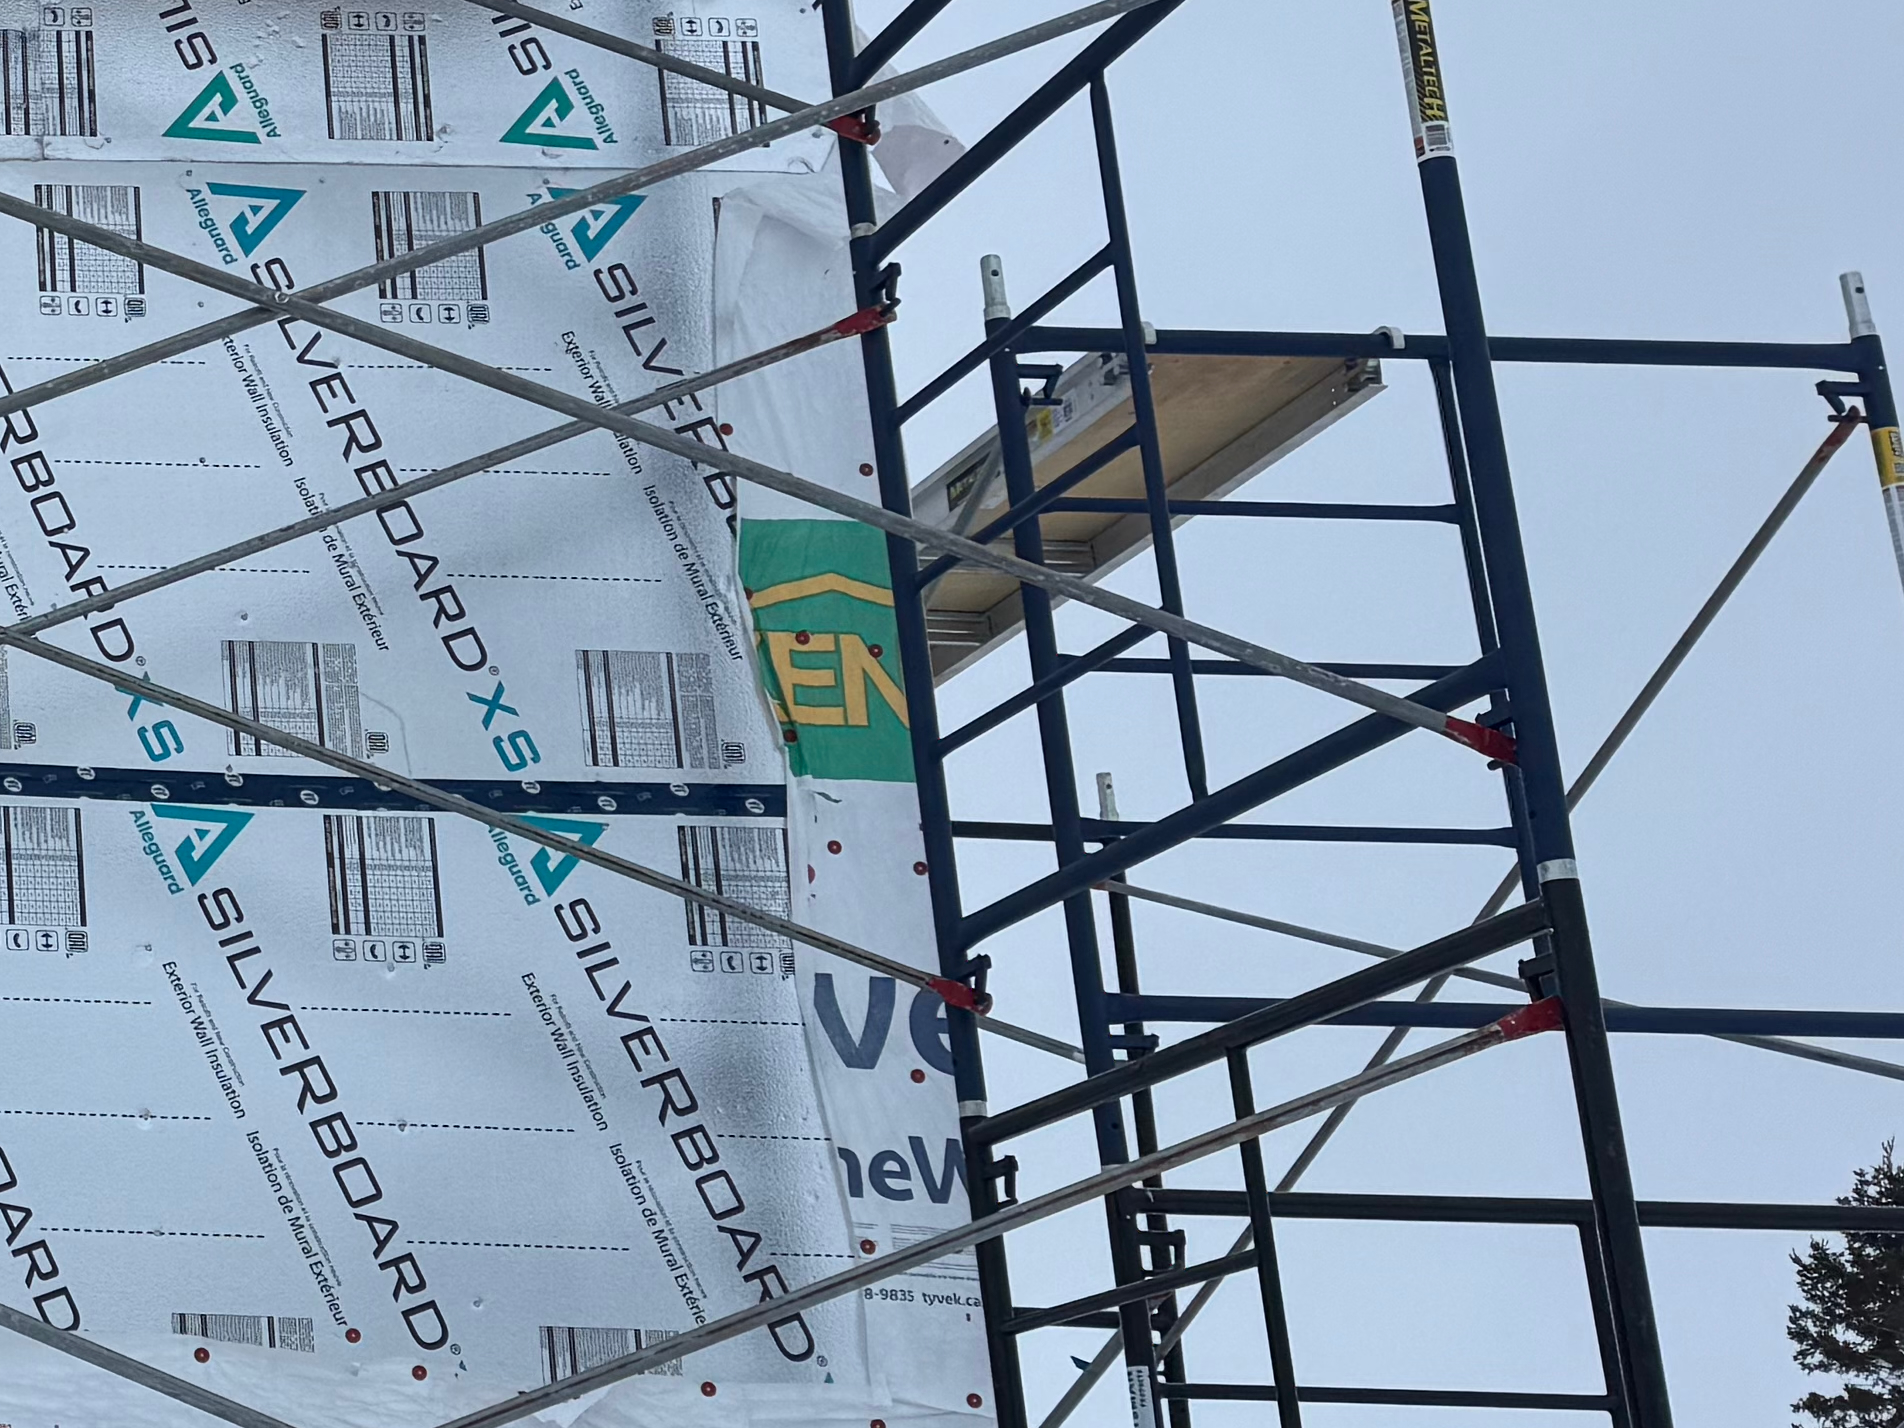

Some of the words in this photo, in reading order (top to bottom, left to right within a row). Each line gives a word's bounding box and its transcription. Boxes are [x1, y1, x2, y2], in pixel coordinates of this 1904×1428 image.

[230, 61, 282, 140] Alleguard
[563, 67, 620, 145] Alleguard
[185, 188, 238, 266] Alleguard
[465, 680, 543, 773] XS
[130, 809, 185, 895] Alleguard
[162, 960, 196, 1017] Exterior
[189, 1014, 216, 1048] Wall
[204, 1042, 247, 1120] Insulation
[521, 972, 556, 1029] Exterior
[550, 1025, 576, 1061] Wall
[565, 1054, 609, 1132] Insulation
[245, 1130, 284, 1194] Isolation
[277, 1190, 294, 1214] de
[288, 1211, 314, 1260] Mural
[308, 1254, 349, 1329] Extérieur
[609, 1142, 648, 1206] Isolation
[641, 1203, 658, 1228] de
[651, 1225, 677, 1273] Mural
